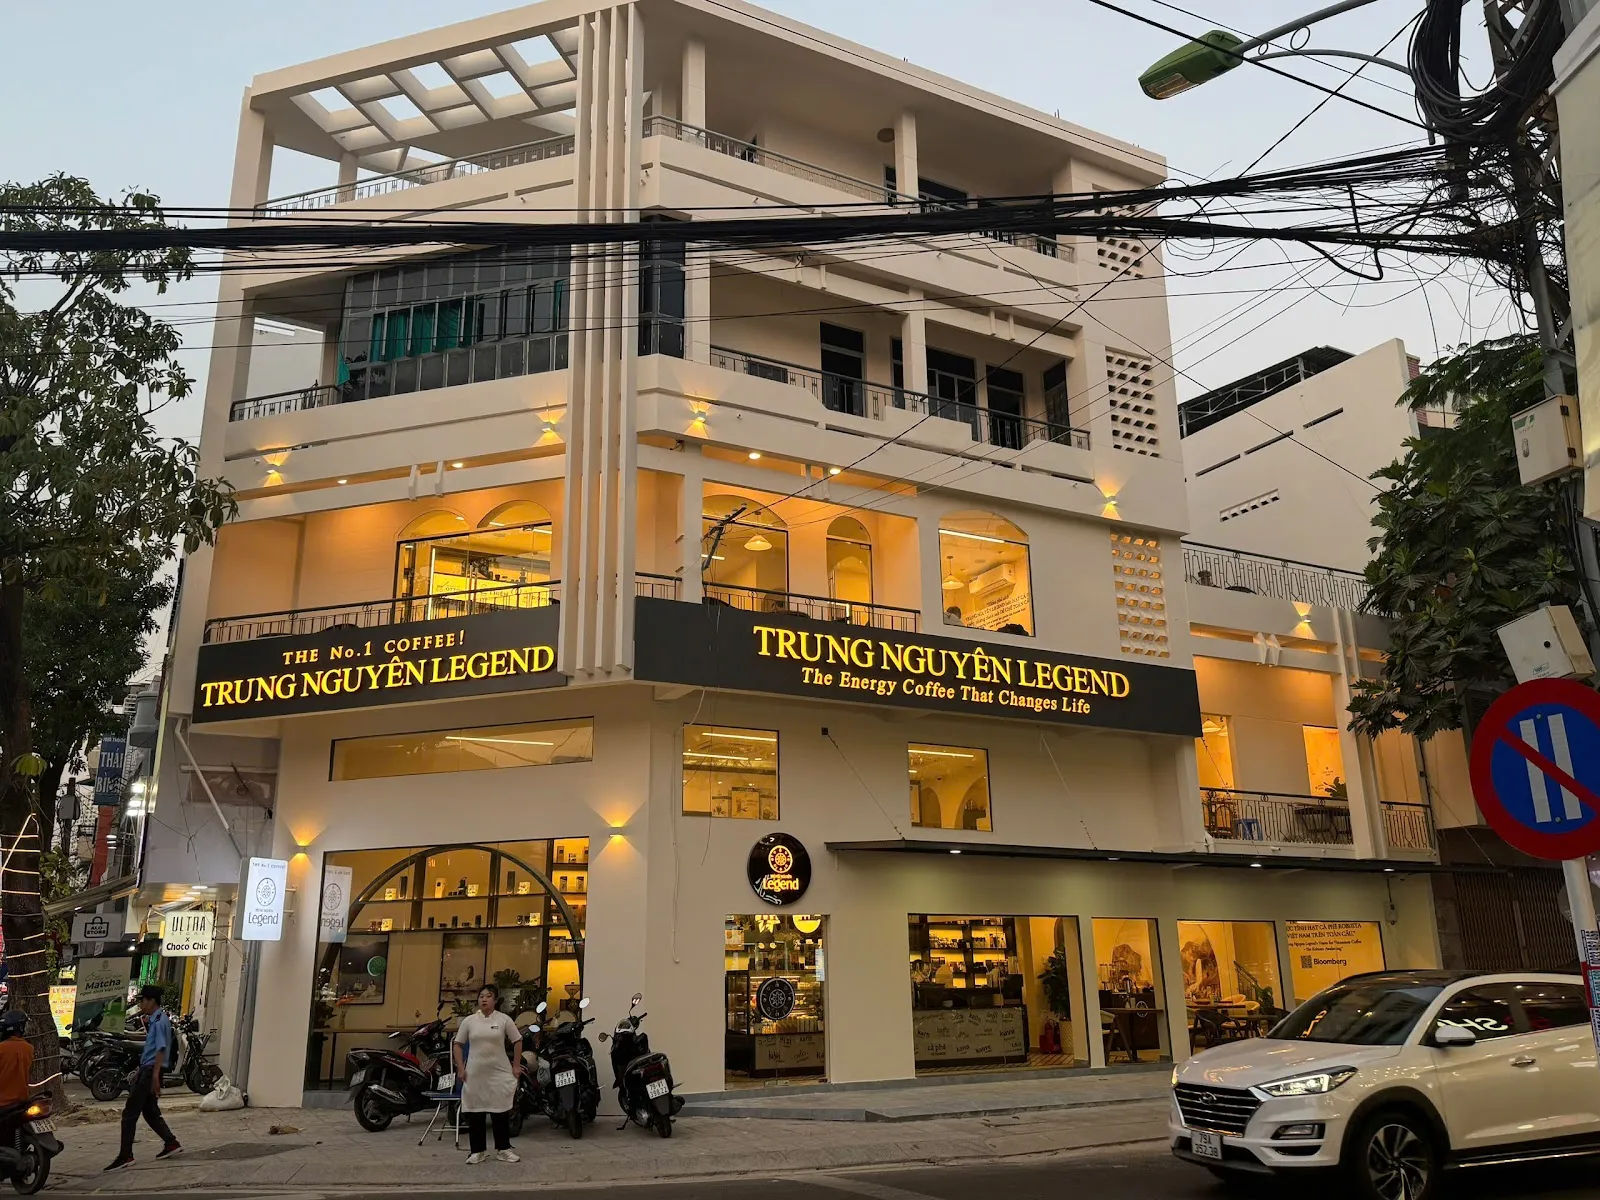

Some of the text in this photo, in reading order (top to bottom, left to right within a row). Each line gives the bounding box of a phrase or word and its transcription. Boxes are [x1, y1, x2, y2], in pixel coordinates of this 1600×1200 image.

[283, 630, 465, 665] THE No.1 COFFEE!
[754, 626, 1129, 698] TRUNG NGUYÊN LEGEND
[201, 645, 555, 707] TRUNG NGUYÊN LEGEND
[802, 667, 1090, 714] The Energy Coffee That Changes Life
[763, 878, 798, 892] Legend
[172, 916, 205, 931] ULTRA
[248, 912, 278, 926] Legend
[85, 979, 120, 991] Matcha
